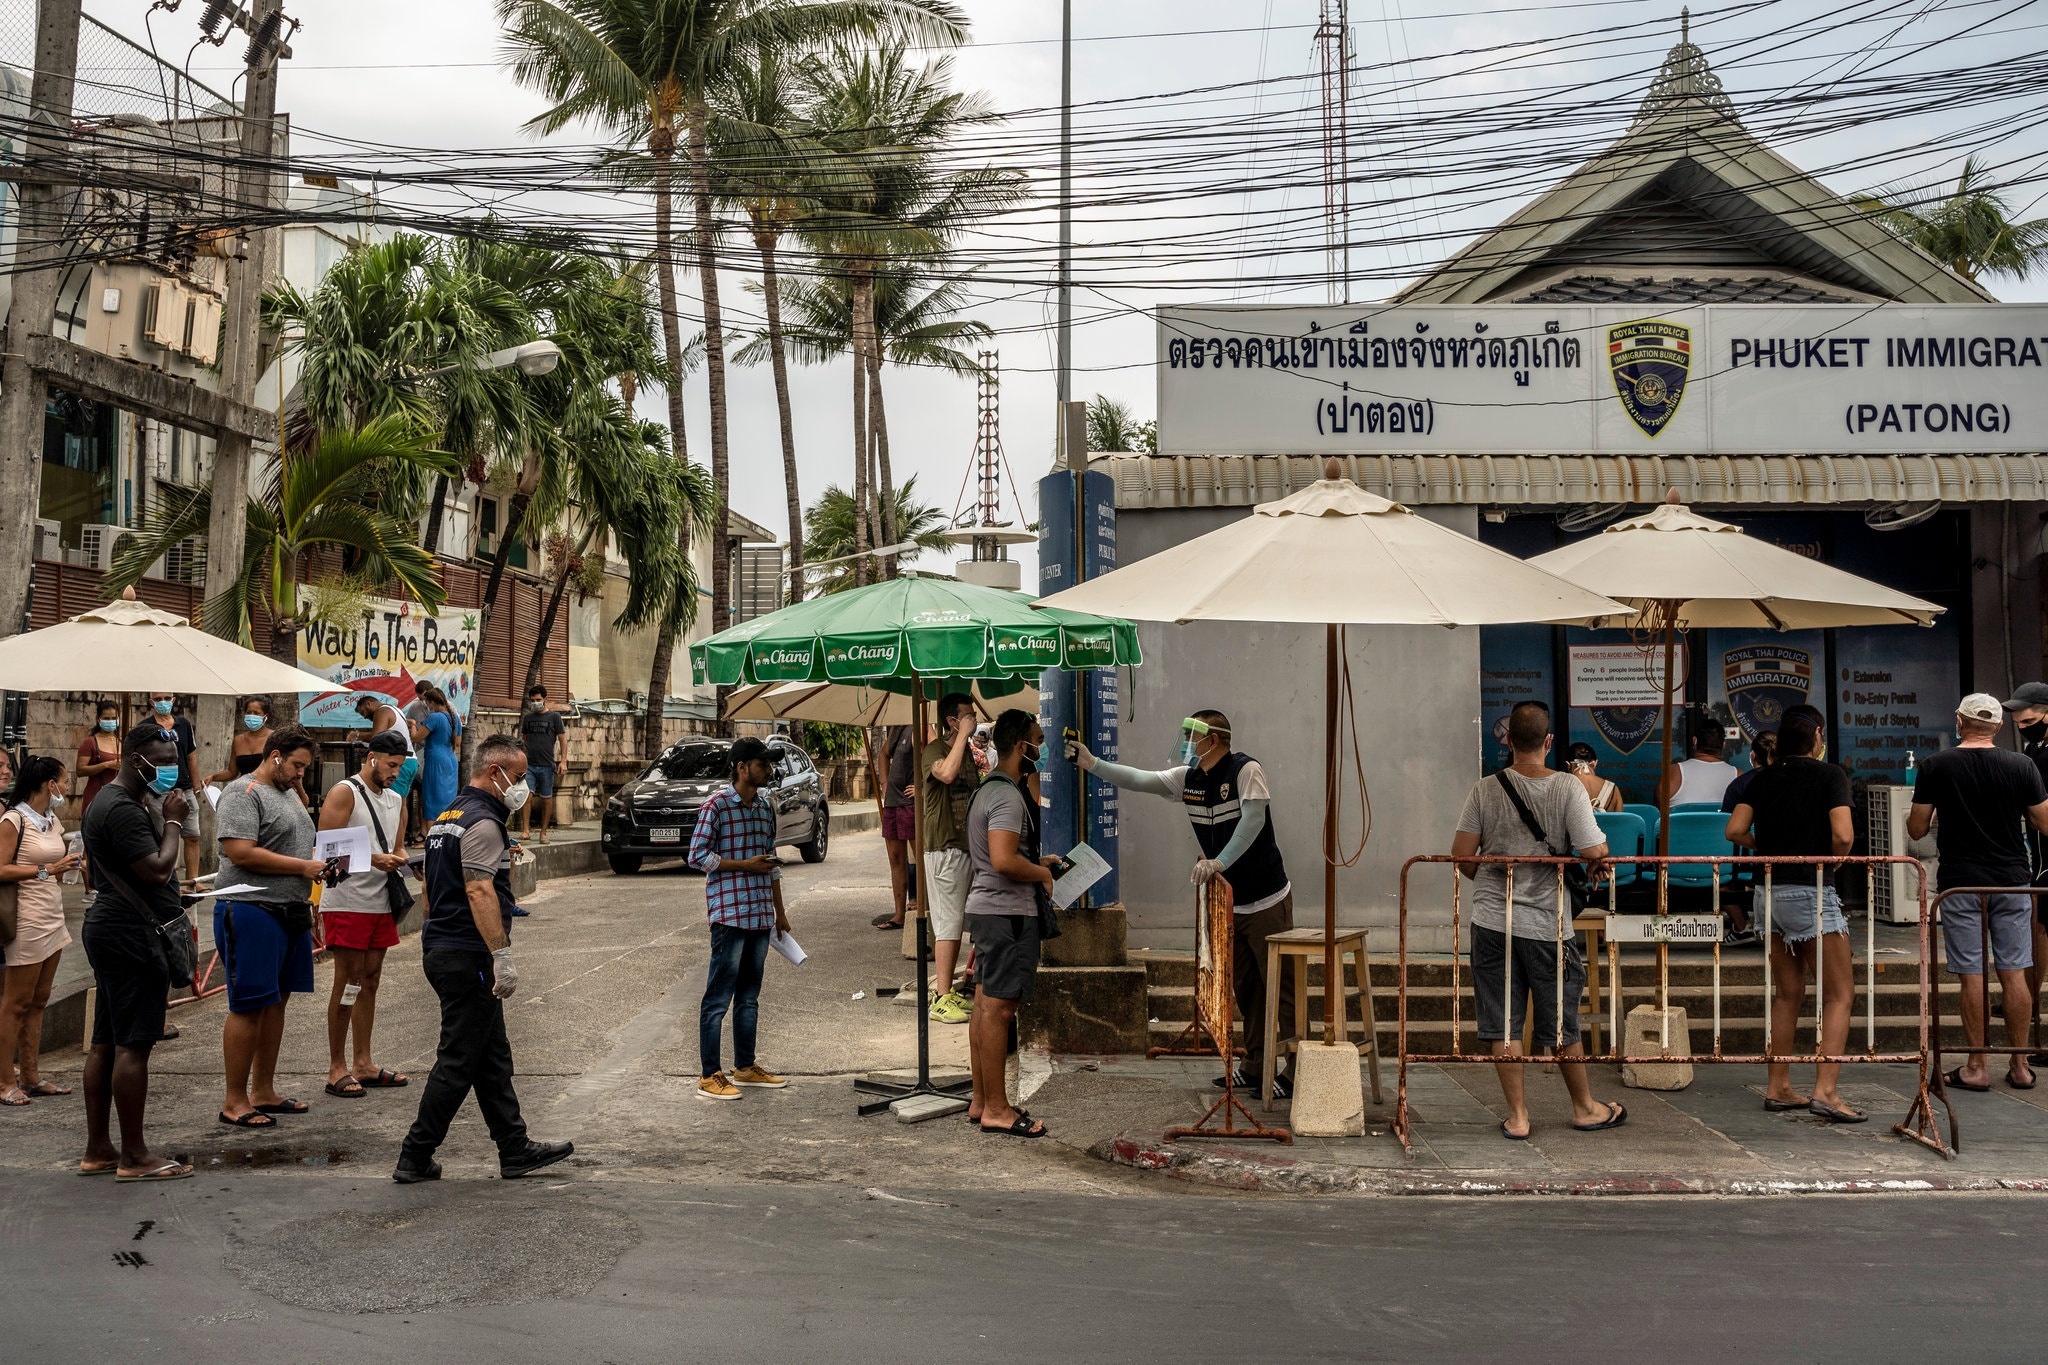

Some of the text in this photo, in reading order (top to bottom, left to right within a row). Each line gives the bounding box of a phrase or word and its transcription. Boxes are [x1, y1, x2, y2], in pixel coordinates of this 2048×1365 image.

[1612, 325, 1686, 340] ROYAL THAI POLICE
[1168, 320, 1581, 386] ตรวจคนเข้าเมืองจังหวัดภูเก็ต
[1613, 349, 1687, 364] IMMIGRATION BUREAU
[1731, 338, 1869, 368] PHUKET
[1316, 381, 1435, 436] (ป่าตอง)
[1846, 403, 2011, 434] (PATONG)
[1045, 564, 1062, 580] CENTER
[303, 601, 476, 669] Way To The Beach
[1018, 635, 1057, 653] Chang
[1083, 637, 1111, 653] Chang
[770, 649, 810, 666] Chang
[847, 645, 895, 661] Chang
[1726, 649, 1808, 663] ROYAL THAI POLICE
[1727, 673, 1808, 689] IMMIGRATION
[1853, 670, 1892, 683] Extension
[1854, 692, 1917, 707] Re-Entry Permit
[316, 699, 342, 717] Water
[1855, 714, 1920, 728] Notify of Staying
[1855, 736, 1883, 750] Longer
[1886, 735, 1905, 747] Than
[1919, 735, 1940, 749] Days
[1855, 757, 1896, 769] Certificate
